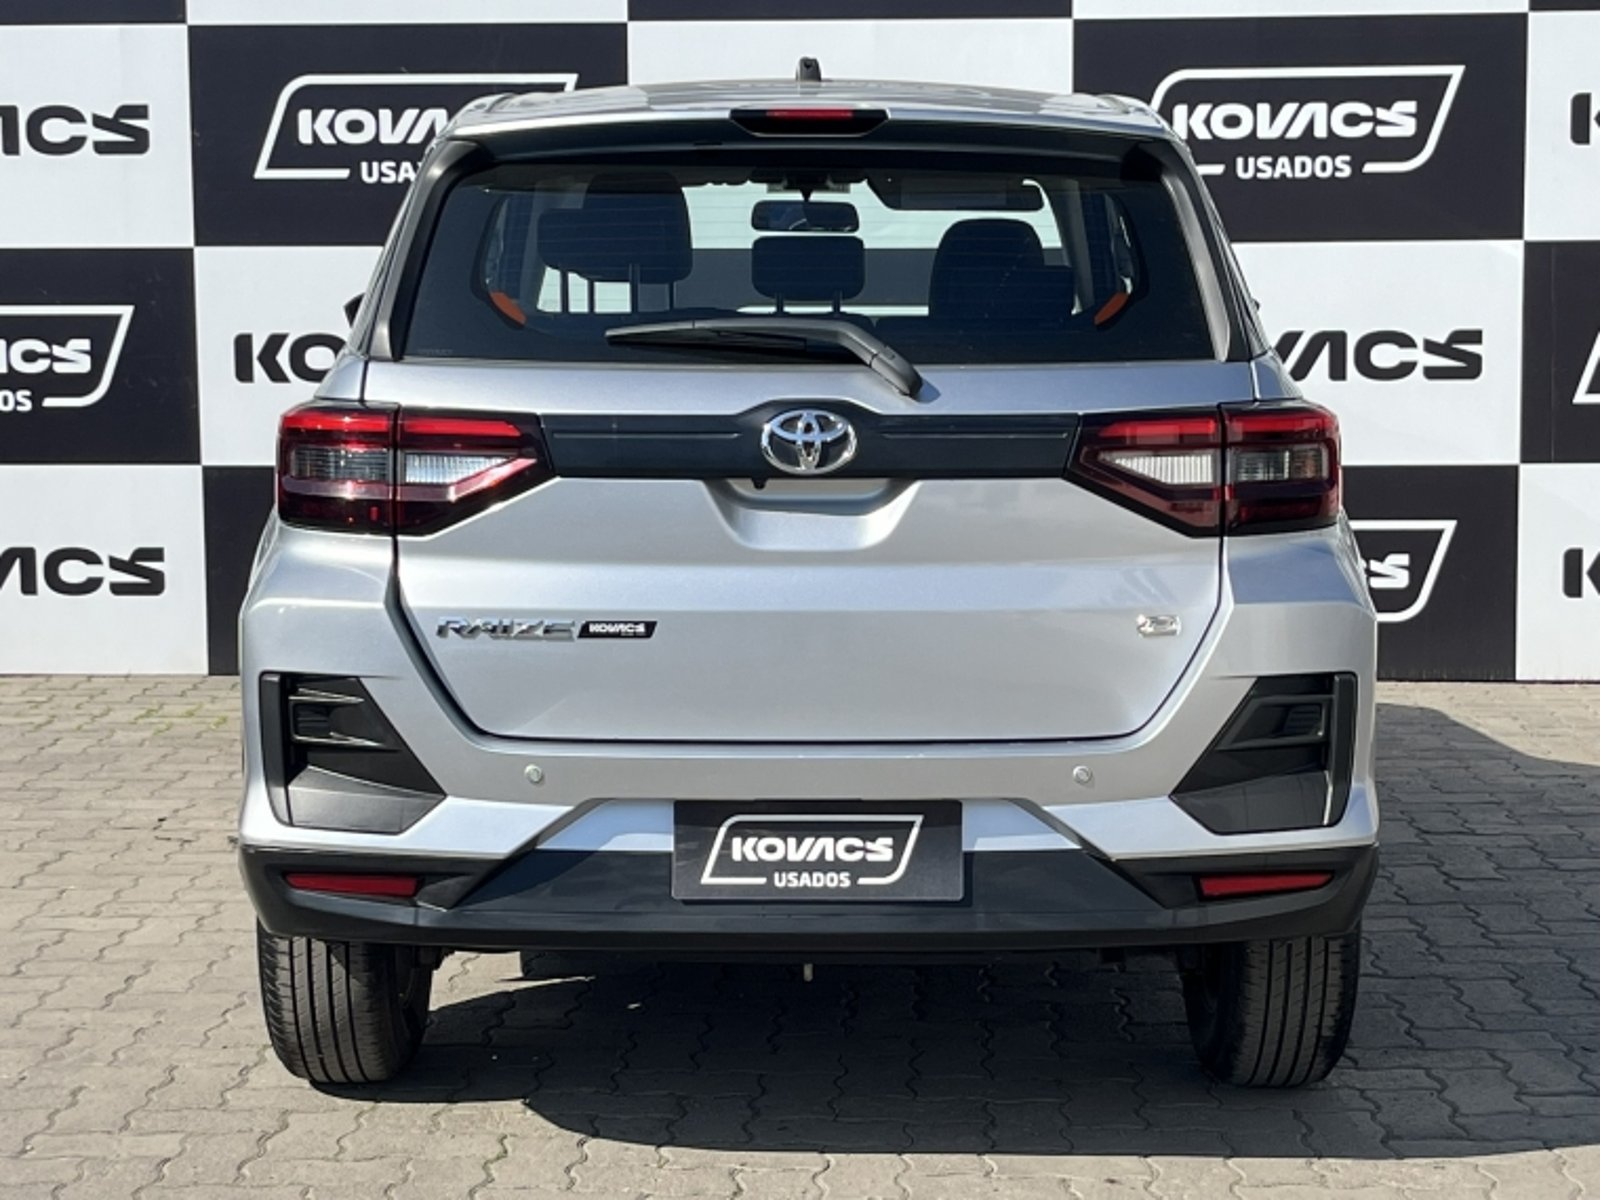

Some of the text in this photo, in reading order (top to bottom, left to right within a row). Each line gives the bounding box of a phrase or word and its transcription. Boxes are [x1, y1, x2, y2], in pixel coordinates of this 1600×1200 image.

[1172, 100, 1417, 140] KOVACS
[1235, 155, 1352, 179] USADOS
[0, 338, 92, 374] CS
[435, 616, 575, 641] RAIZE
[731, 836, 893, 862] KOVACS
[773, 871, 851, 888] USADOS
